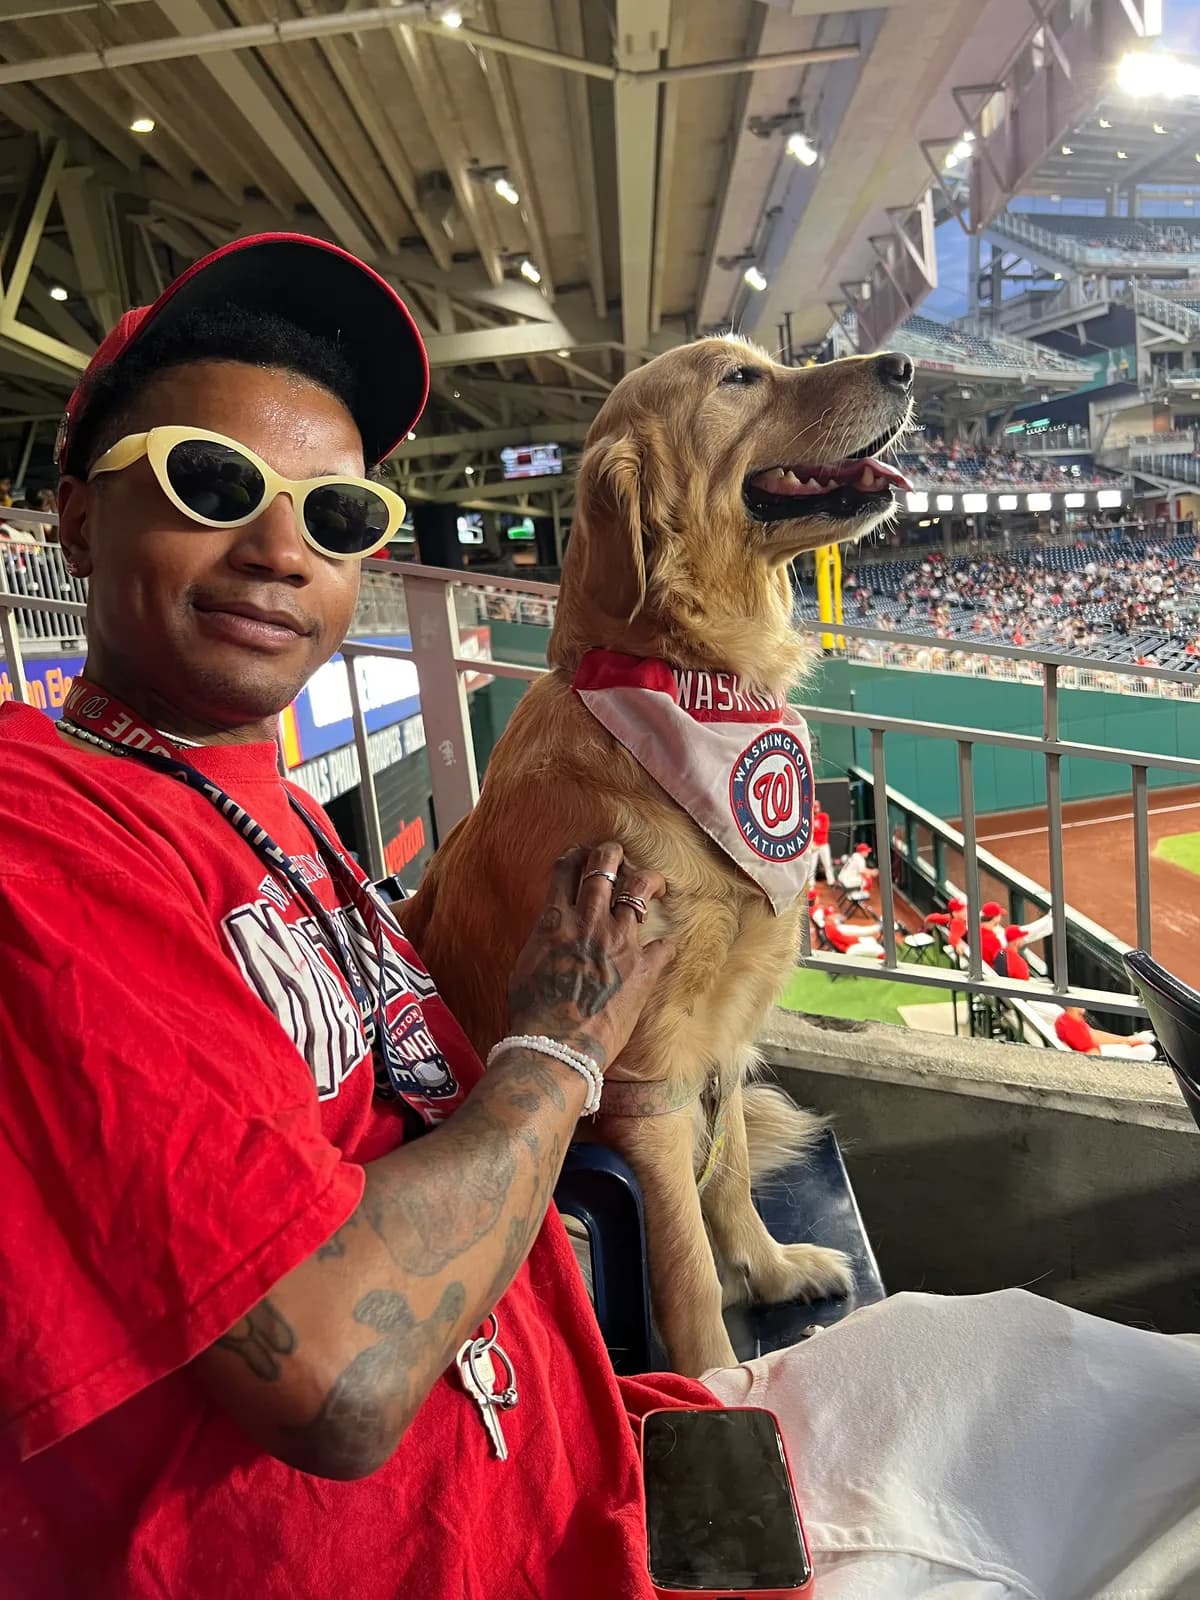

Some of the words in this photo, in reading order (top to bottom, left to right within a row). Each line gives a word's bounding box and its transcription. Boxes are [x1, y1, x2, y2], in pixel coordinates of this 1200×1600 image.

[733, 733, 808, 784] WASHINGTON
[752, 763, 793, 829] W
[743, 816, 810, 858] NATIONALS
